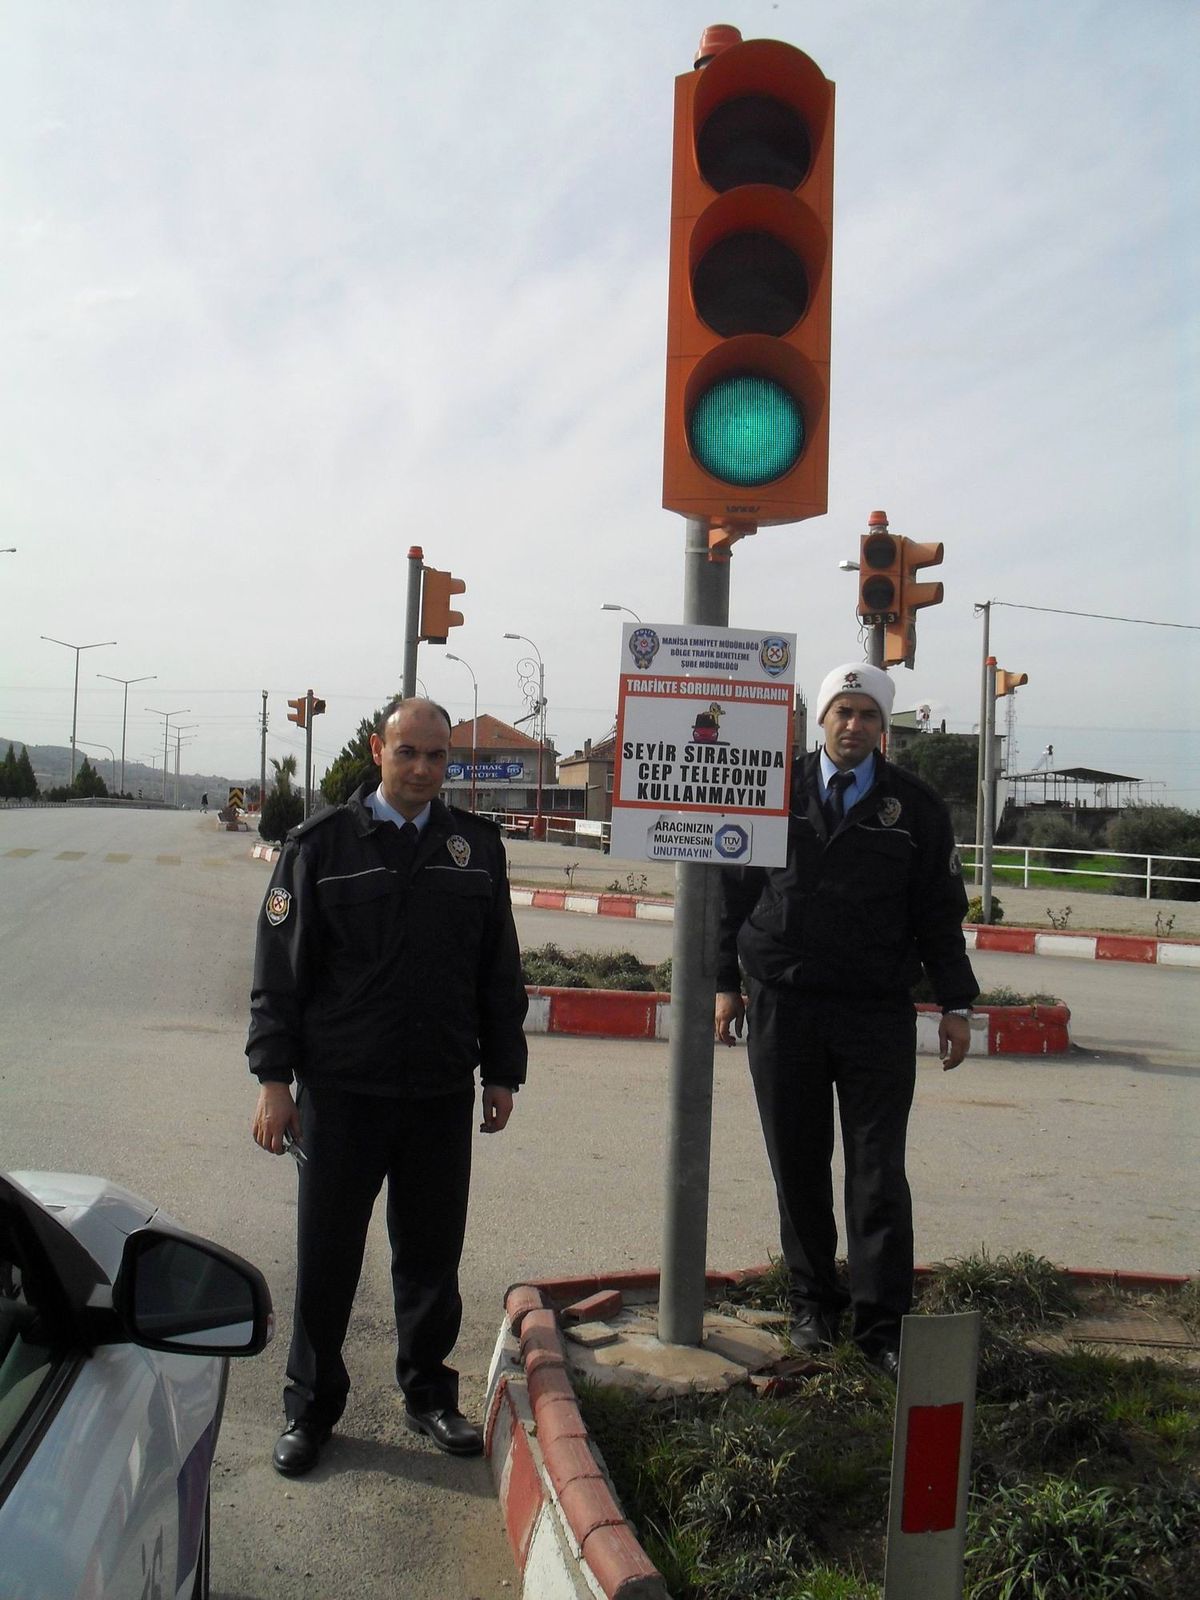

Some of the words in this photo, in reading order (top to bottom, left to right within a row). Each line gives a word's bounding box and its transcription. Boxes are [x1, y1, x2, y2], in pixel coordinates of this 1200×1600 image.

[661, 637, 688, 646] MANİSA
[689, 638, 718, 648] EMNİYET
[670, 648, 691, 657] BÖLGE
[692, 649, 715, 659] TRAFİK
[715, 651, 750, 661] DENETLEME
[681, 660, 698, 669] ŞUBE
[627, 678, 678, 694] TRAFİKTE
[679, 682, 733, 697] SORUMLU
[735, 686, 789, 701] DAVRANIN
[623, 741, 677, 762] SEYİR
[684, 745, 784, 769] SIRASINDA
[638, 762, 673, 781] CEP
[680, 765, 768, 787] TELEFONU
[637, 782, 766, 807] KULLANMAYIN
[655, 821, 714, 834] ARACINIZIN
[653, 846, 713, 859] UNUTMAYIN!
